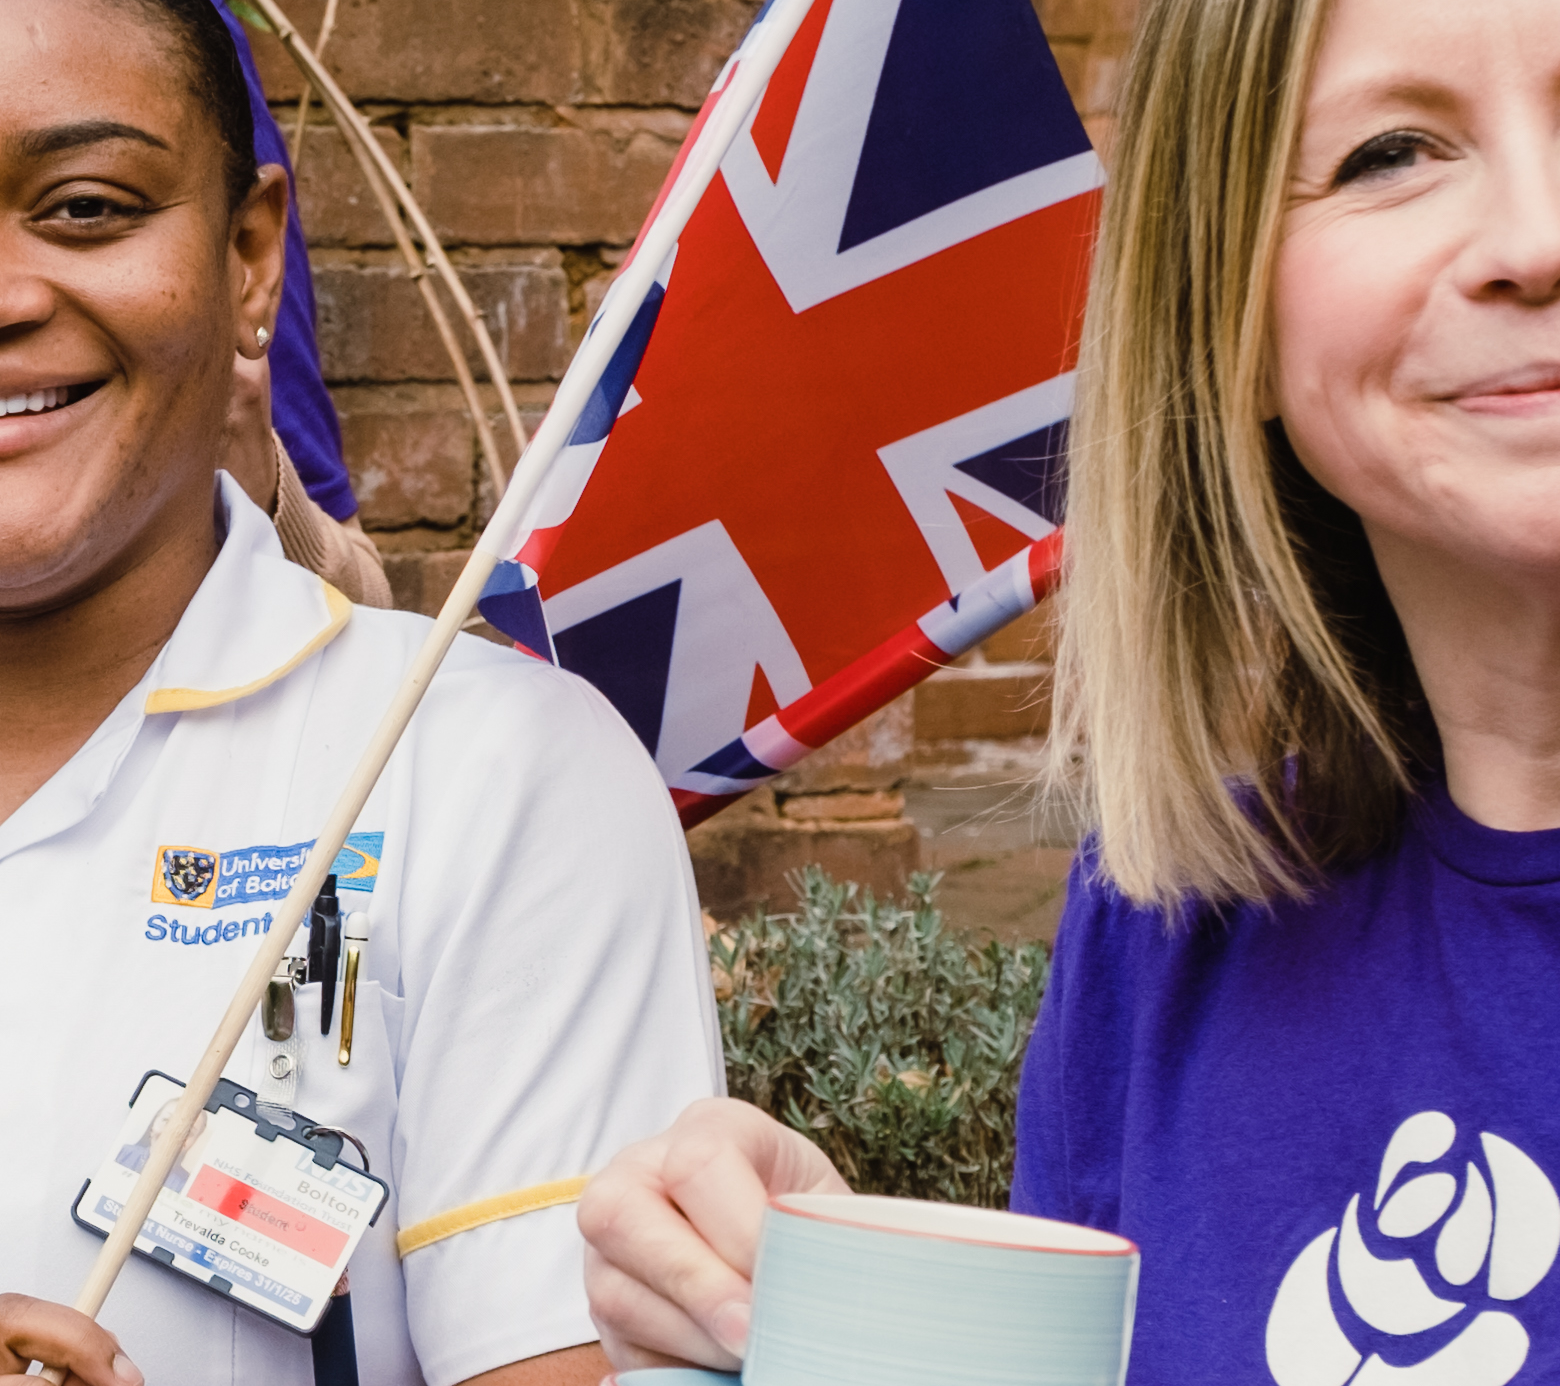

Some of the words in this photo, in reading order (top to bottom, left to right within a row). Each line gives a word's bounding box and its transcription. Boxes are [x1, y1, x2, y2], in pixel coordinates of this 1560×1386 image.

[217, 877, 241, 898] of
[144, 911, 274, 946] Student
[212, 1156, 242, 1179] NHS
[243, 1172, 316, 1214] Foundation
[320, 1208, 354, 1233] Trust
[238, 1197, 291, 1232] Student
[295, 1179, 361, 1220] Bolton
[156, 1222, 195, 1253] Nurse
[204, 1249, 253, 1282] Expires
[172, 1210, 227, 1246] Trevalda
[230, 1241, 271, 1269] Cooke
